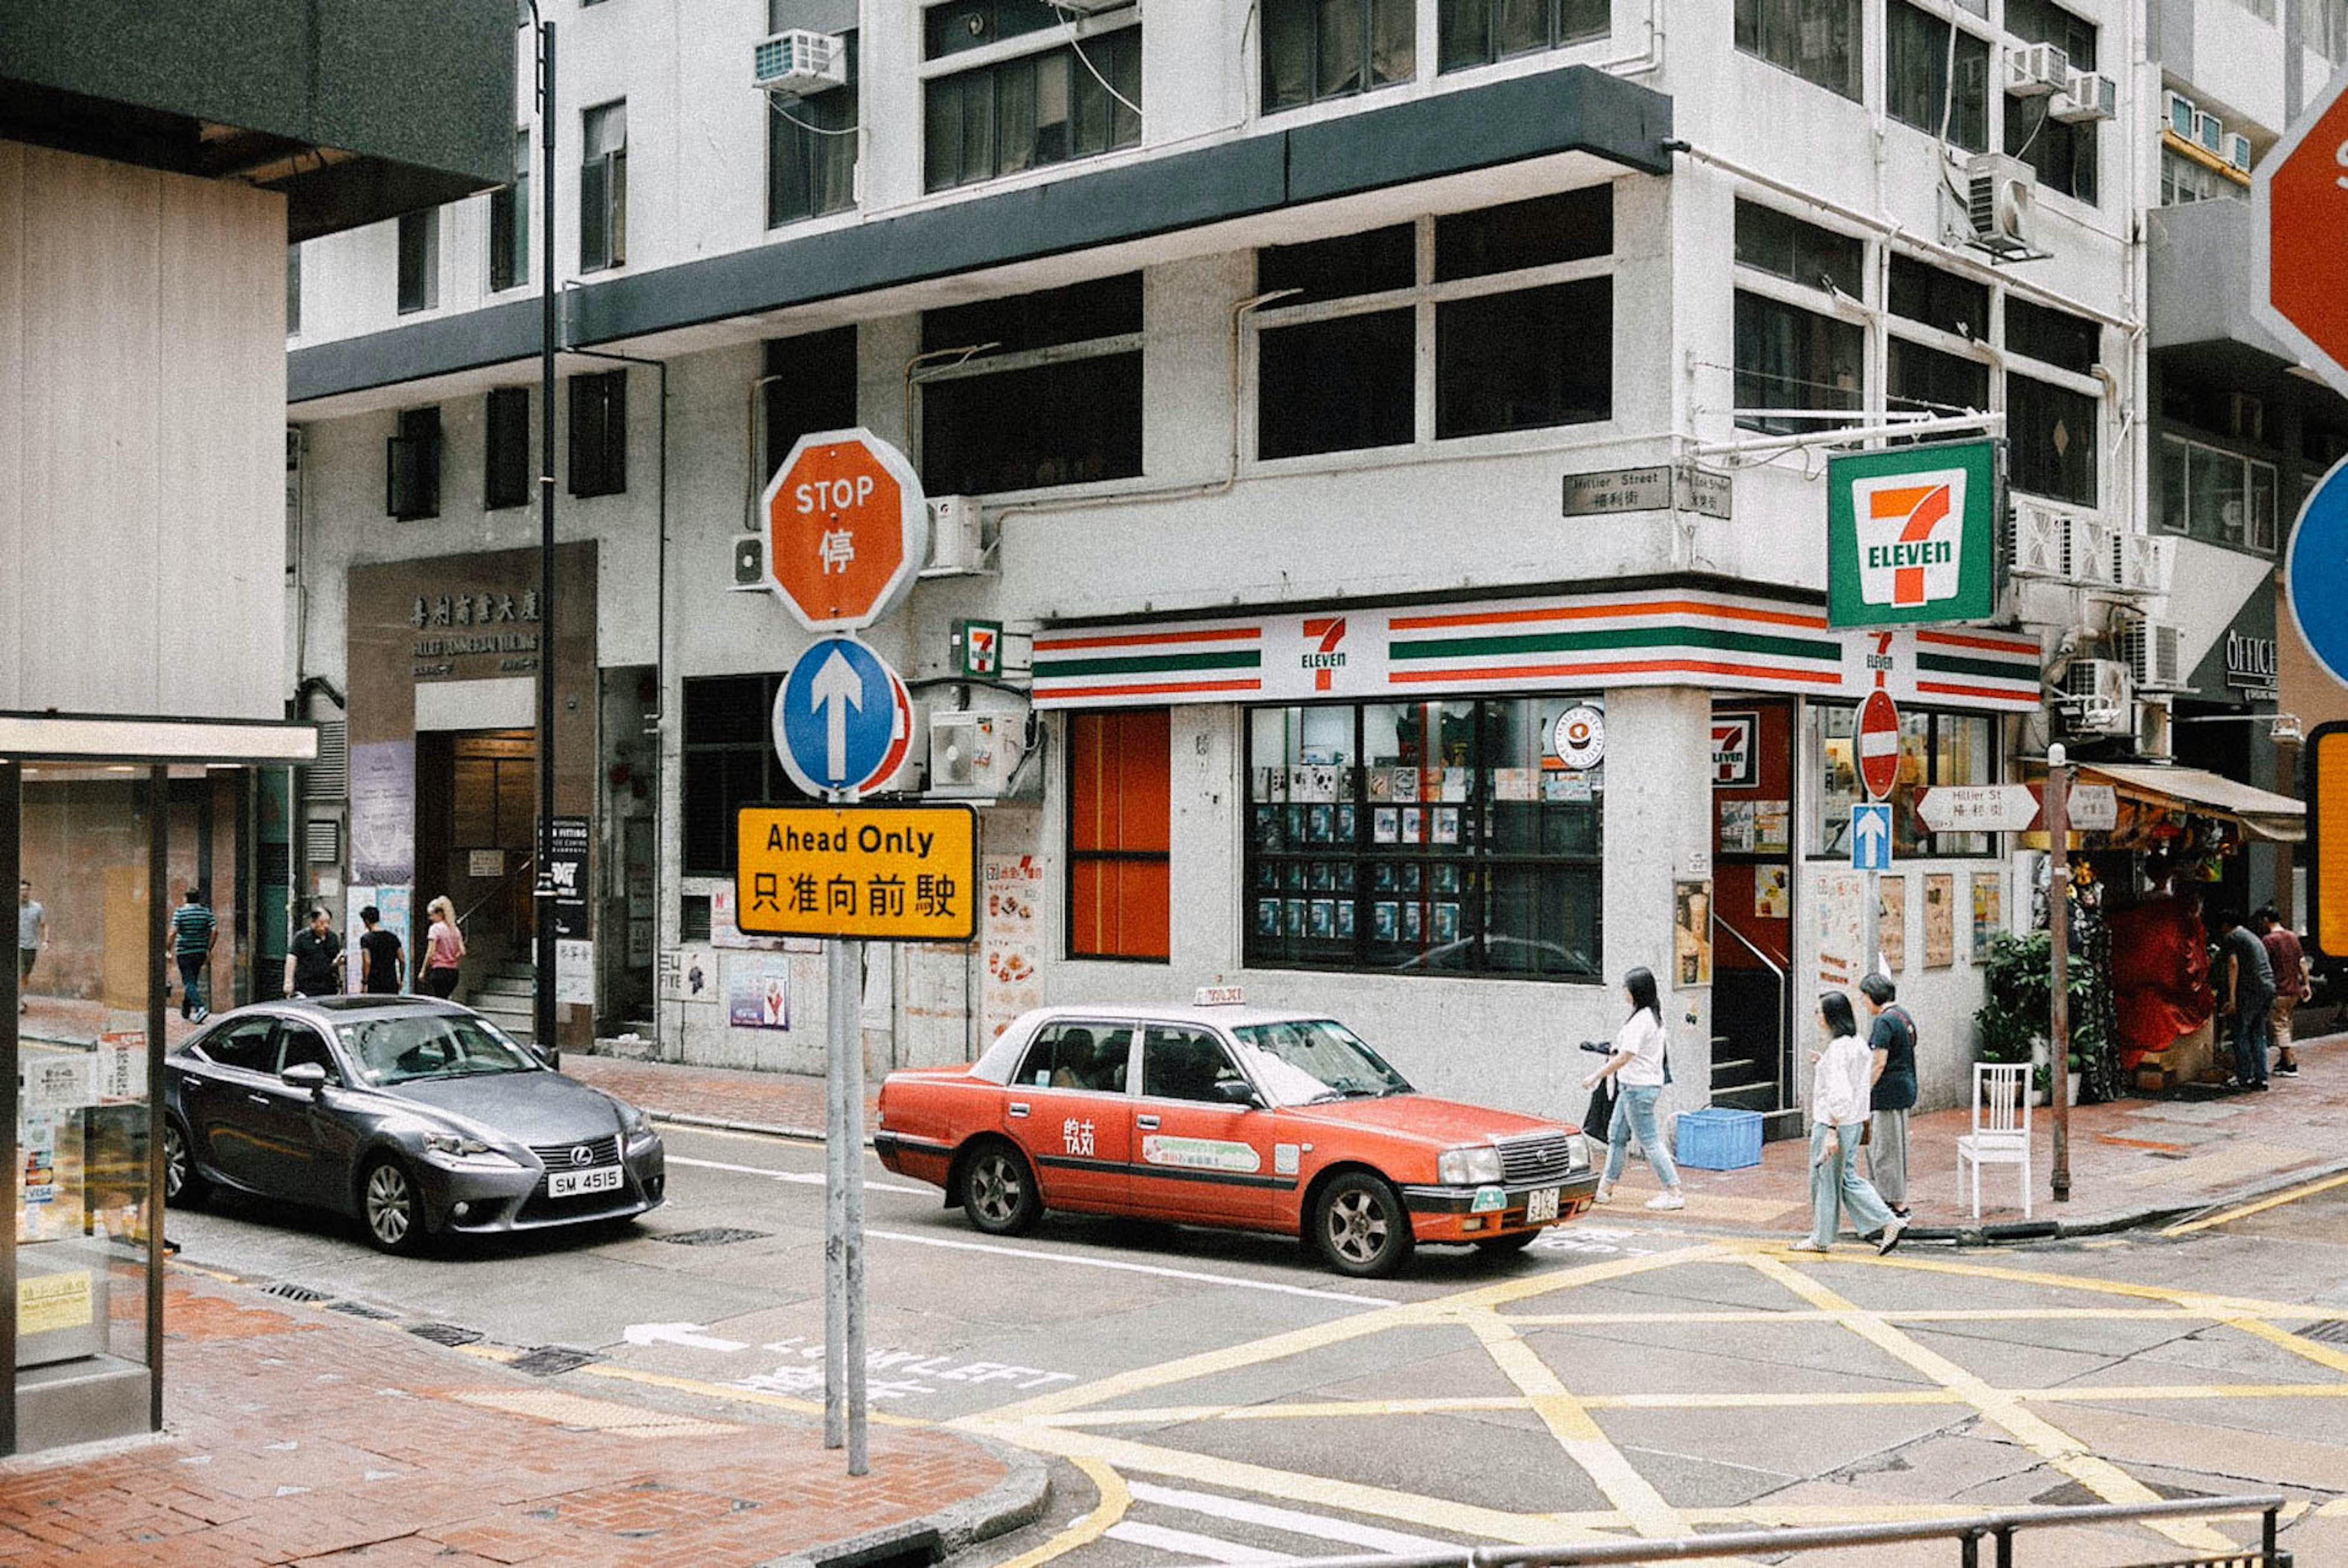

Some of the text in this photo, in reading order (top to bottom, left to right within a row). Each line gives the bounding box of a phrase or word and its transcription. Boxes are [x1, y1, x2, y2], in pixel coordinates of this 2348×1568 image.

[796, 476, 874, 514] STOP
[1574, 473, 1658, 490] Hillier Street
[819, 528, 855, 575] 停
[2227, 629, 2278, 675] OFFICE
[1953, 790, 2002, 800] Hillier St
[768, 823, 934, 859] Ahead Only
[753, 873, 956, 917] 只准向前駛
[1063, 1118, 1096, 1136] 的士
[1063, 1135, 1094, 1156] TAXI
[556, 1171, 617, 1193] SM 4515
[901, 1356, 1078, 1389] LEFT
